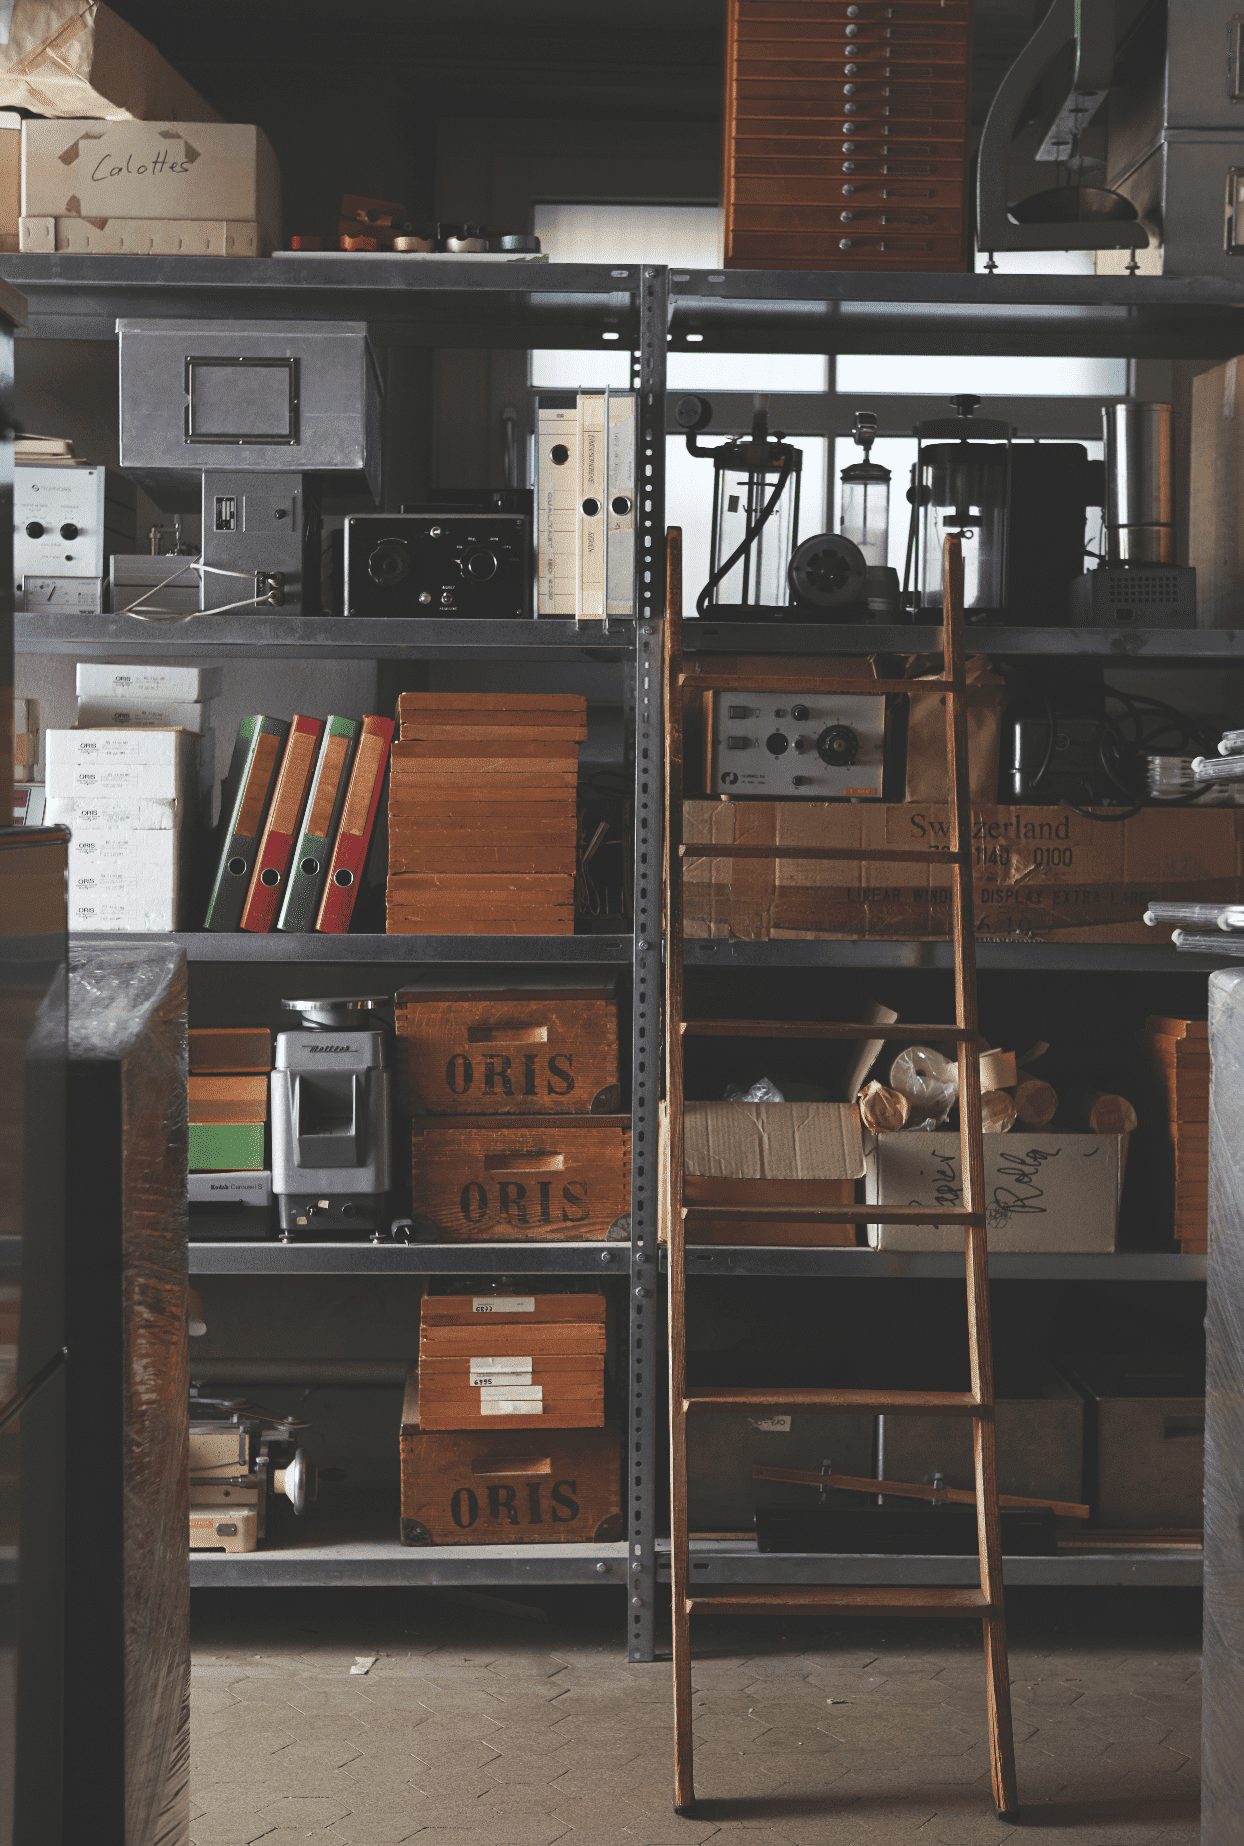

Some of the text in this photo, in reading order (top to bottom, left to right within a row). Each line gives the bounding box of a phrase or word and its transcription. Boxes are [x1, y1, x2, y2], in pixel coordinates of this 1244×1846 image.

[91, 150, 190, 181] Calottes
[911, 813, 1071, 840] Swzerland
[975, 845, 1073, 867] 1140 0100
[847, 888, 901, 903] LINEAR
[912, 888, 953, 903] WIND
[981, 888, 1043, 904] DISPLAY
[446, 1053, 575, 1096] ORIS
[460, 1180, 589, 1223] ORIS
[451, 1480, 579, 1528] ORIS
